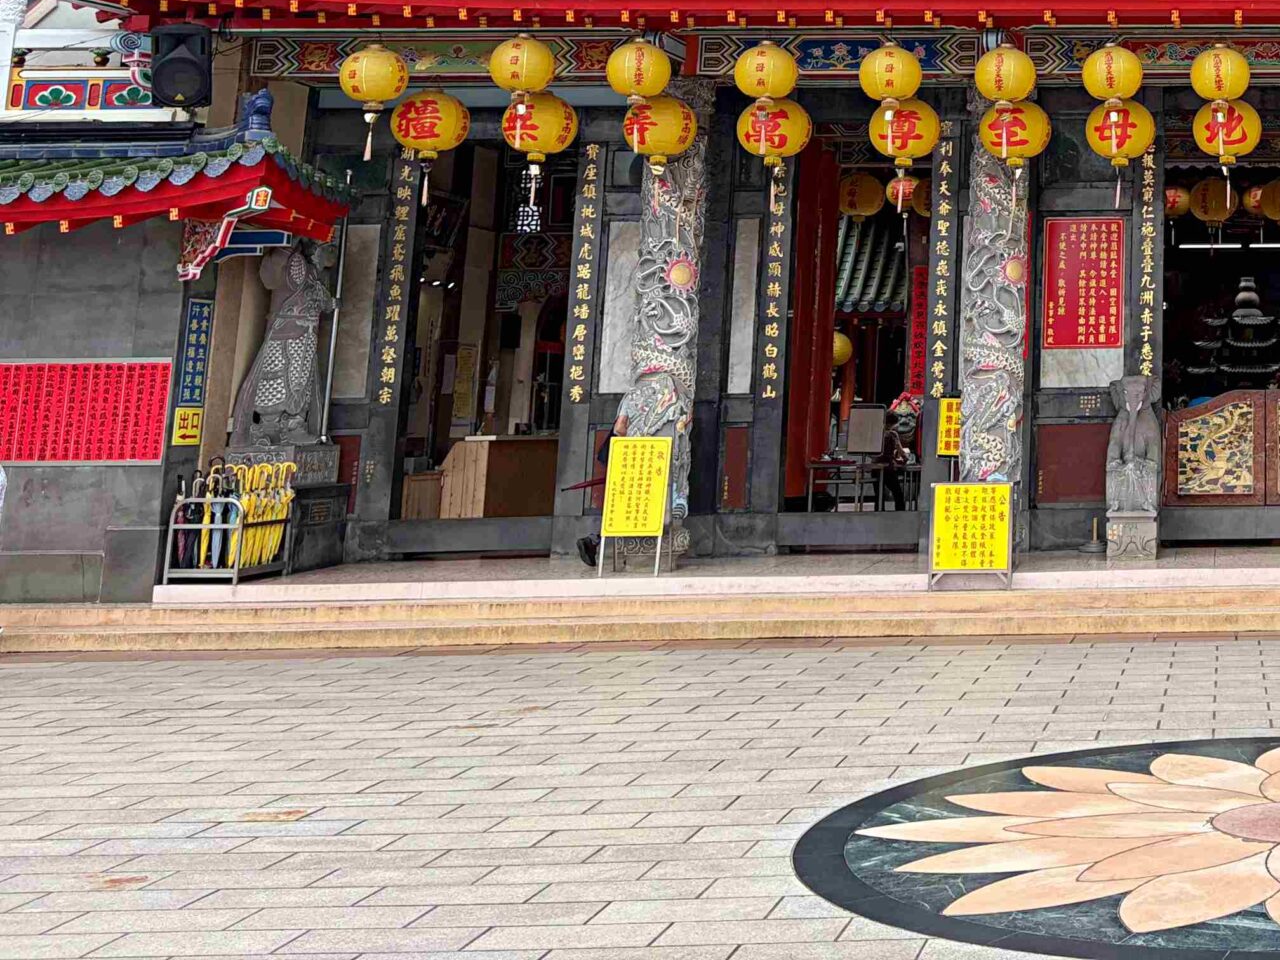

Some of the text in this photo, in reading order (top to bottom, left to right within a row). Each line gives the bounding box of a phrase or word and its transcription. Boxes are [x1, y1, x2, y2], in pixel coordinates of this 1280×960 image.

[396, 100, 441, 140] 疆
[744, 108, 787, 149] 萬
[879, 108, 923, 150] 尊
[988, 107, 1029, 147] 至
[1094, 108, 1137, 149] 母
[1205, 109, 1247, 145] 地
[178, 412, 200, 431] 出口
[998, 494, 1007, 522] 公告
